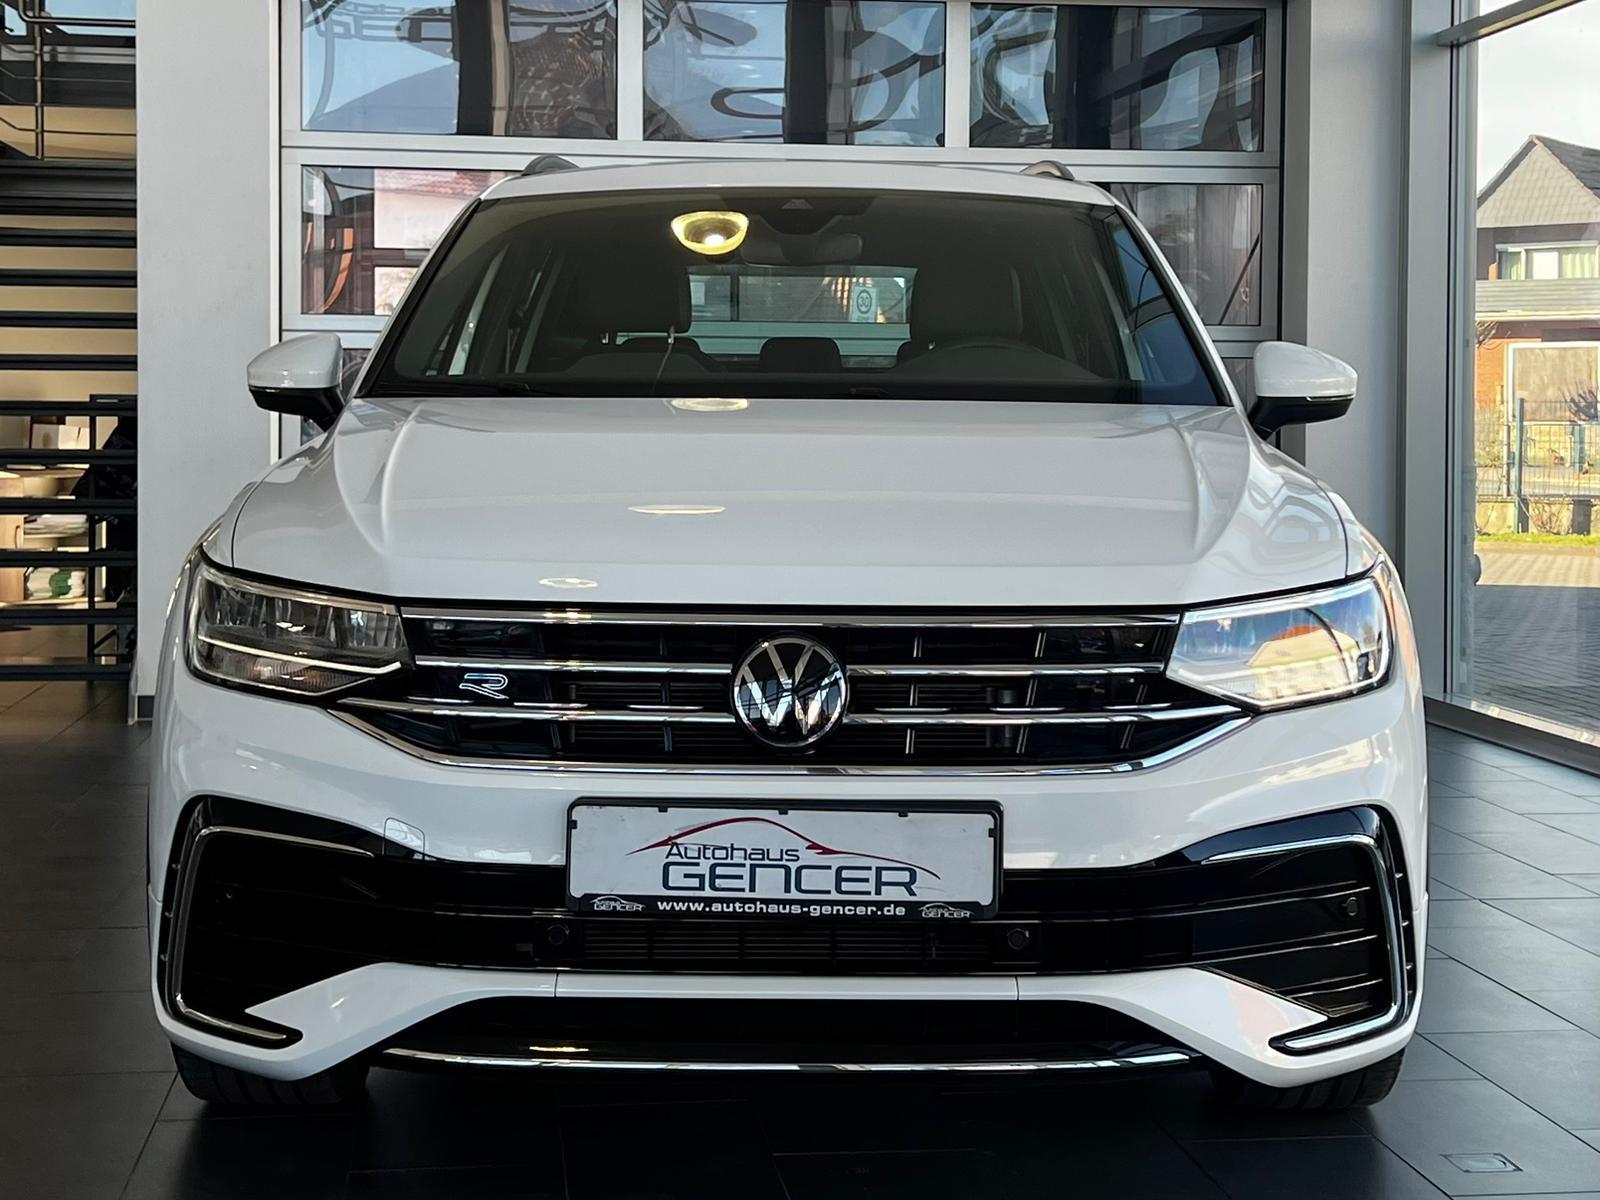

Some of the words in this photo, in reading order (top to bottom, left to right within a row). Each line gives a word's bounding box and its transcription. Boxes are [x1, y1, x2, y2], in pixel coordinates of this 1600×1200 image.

[664, 842, 800, 862] Autohaus
[662, 861, 917, 896] GENCER
[657, 901, 906, 916] www.autohaus-gencer.de
